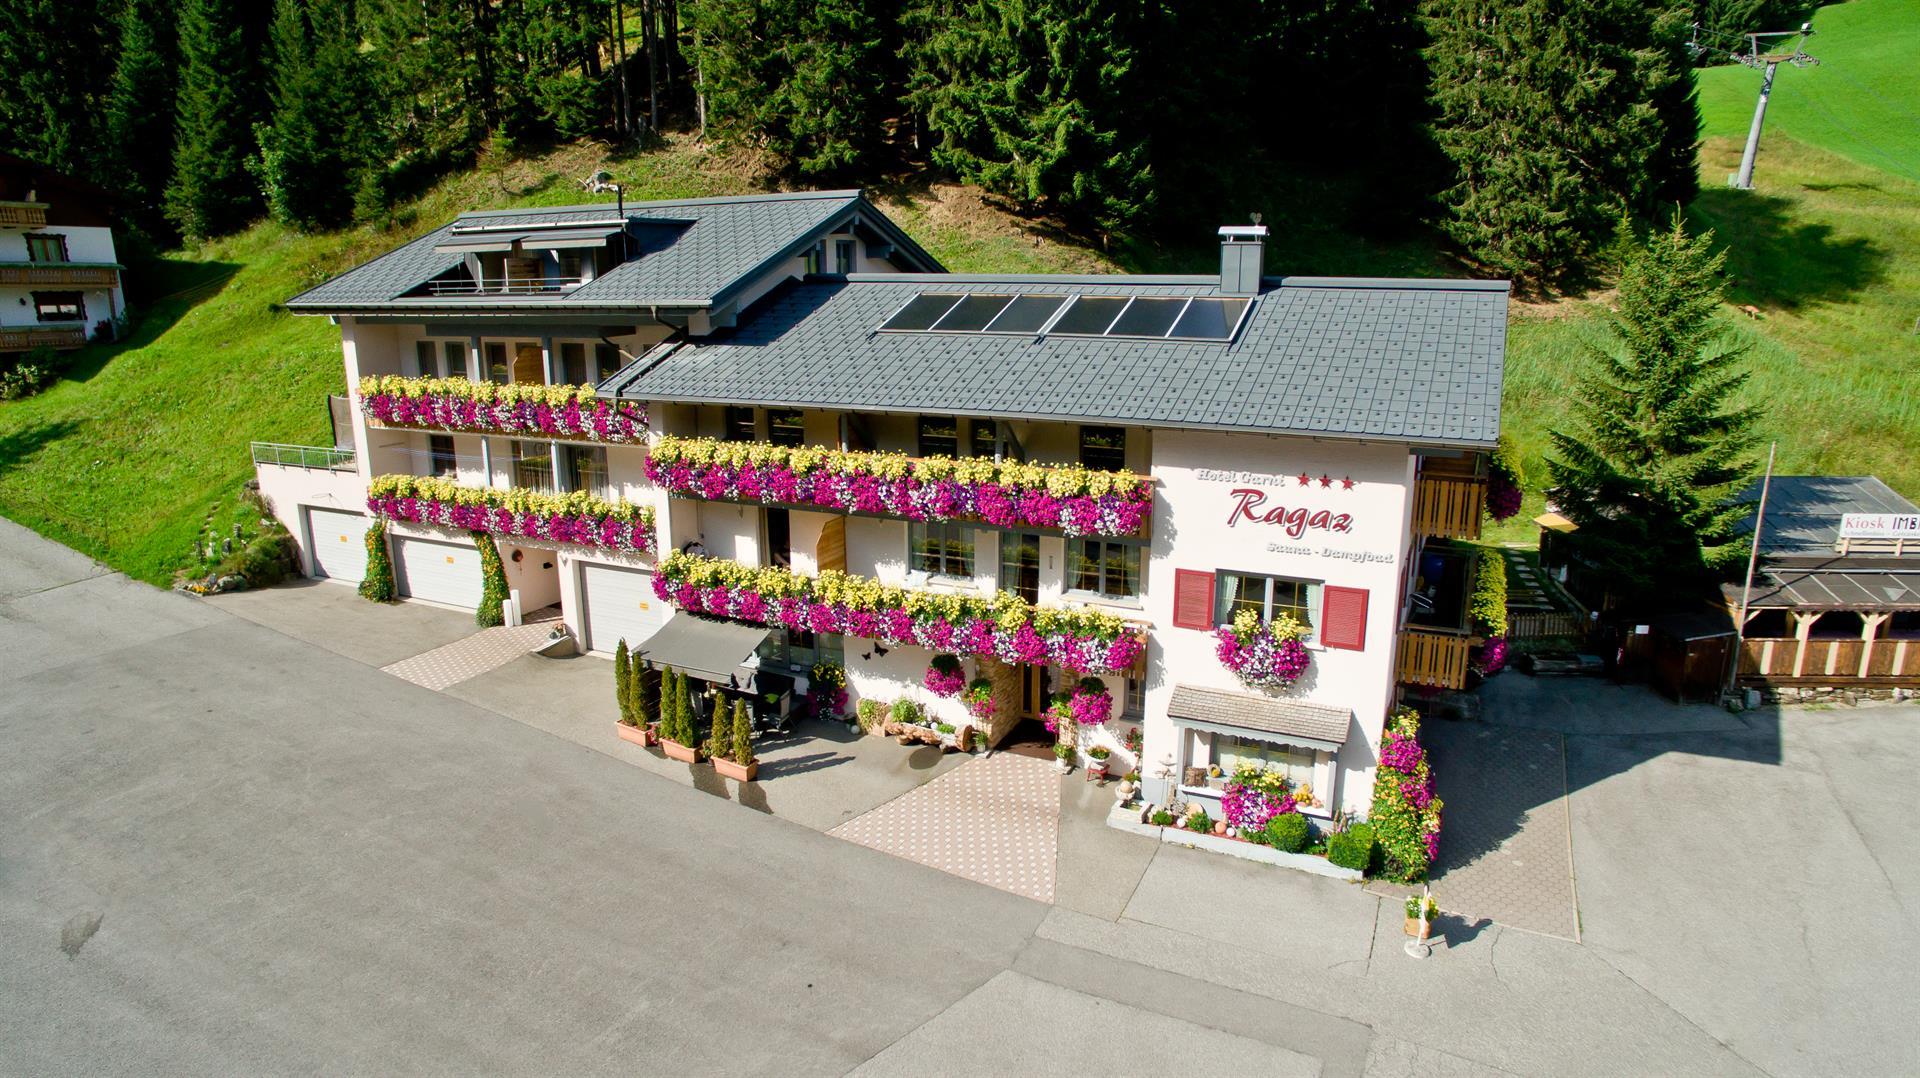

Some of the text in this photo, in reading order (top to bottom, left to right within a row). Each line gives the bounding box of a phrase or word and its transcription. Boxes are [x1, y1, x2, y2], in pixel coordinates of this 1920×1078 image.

[1197, 469, 1286, 487] Hotel Garni
[1227, 488, 1354, 540] Ragaz
[1845, 517, 1920, 530] Kiosk IMB
[1267, 543, 1311, 557] Sauna
[1322, 547, 1394, 564] Dampfbad
